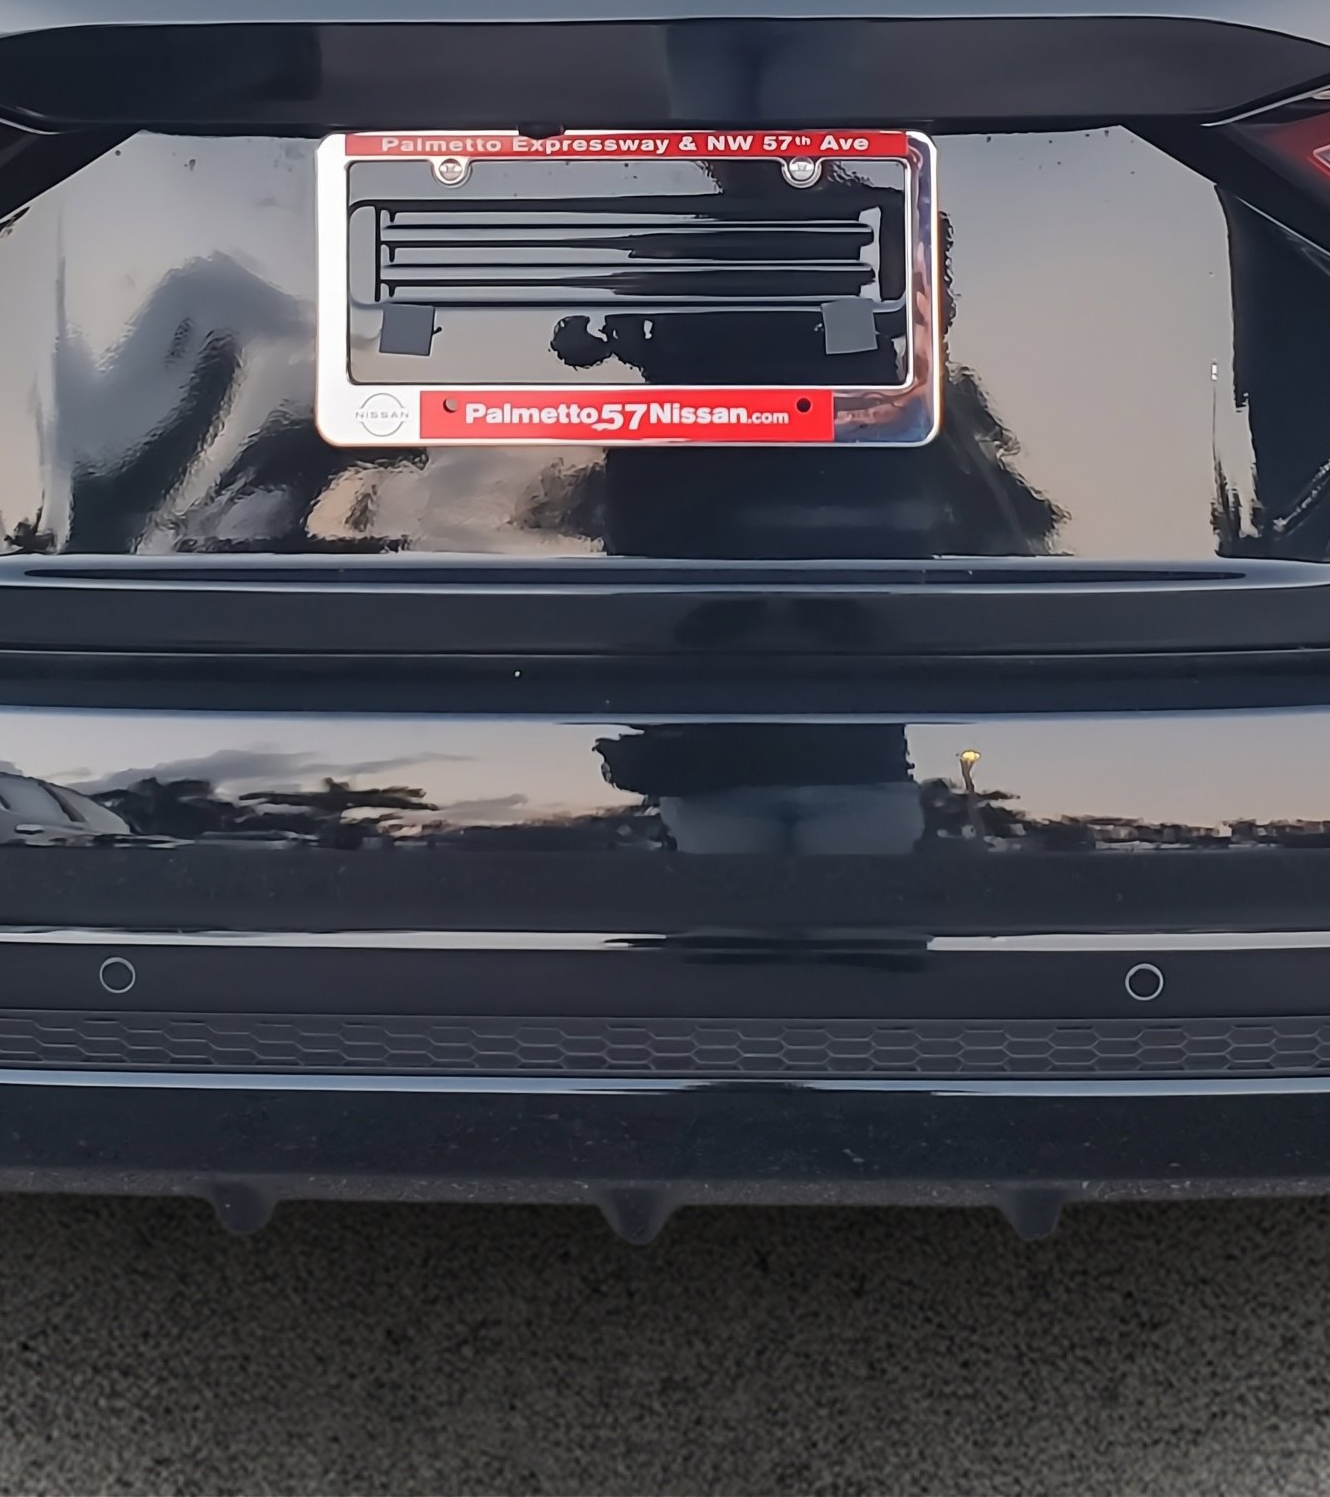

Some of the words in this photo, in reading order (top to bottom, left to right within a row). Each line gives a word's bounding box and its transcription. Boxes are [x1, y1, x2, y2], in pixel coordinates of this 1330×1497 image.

[381, 136, 503, 153] Palmetto
[512, 136, 670, 155] Expressway
[677, 136, 697, 151] &
[707, 135, 754, 151] NW
[762, 135, 812, 151] 57th
[819, 134, 869, 151] Ave
[355, 411, 410, 420] NISSAN
[465, 402, 790, 431] Palmetto57Nissan.com
